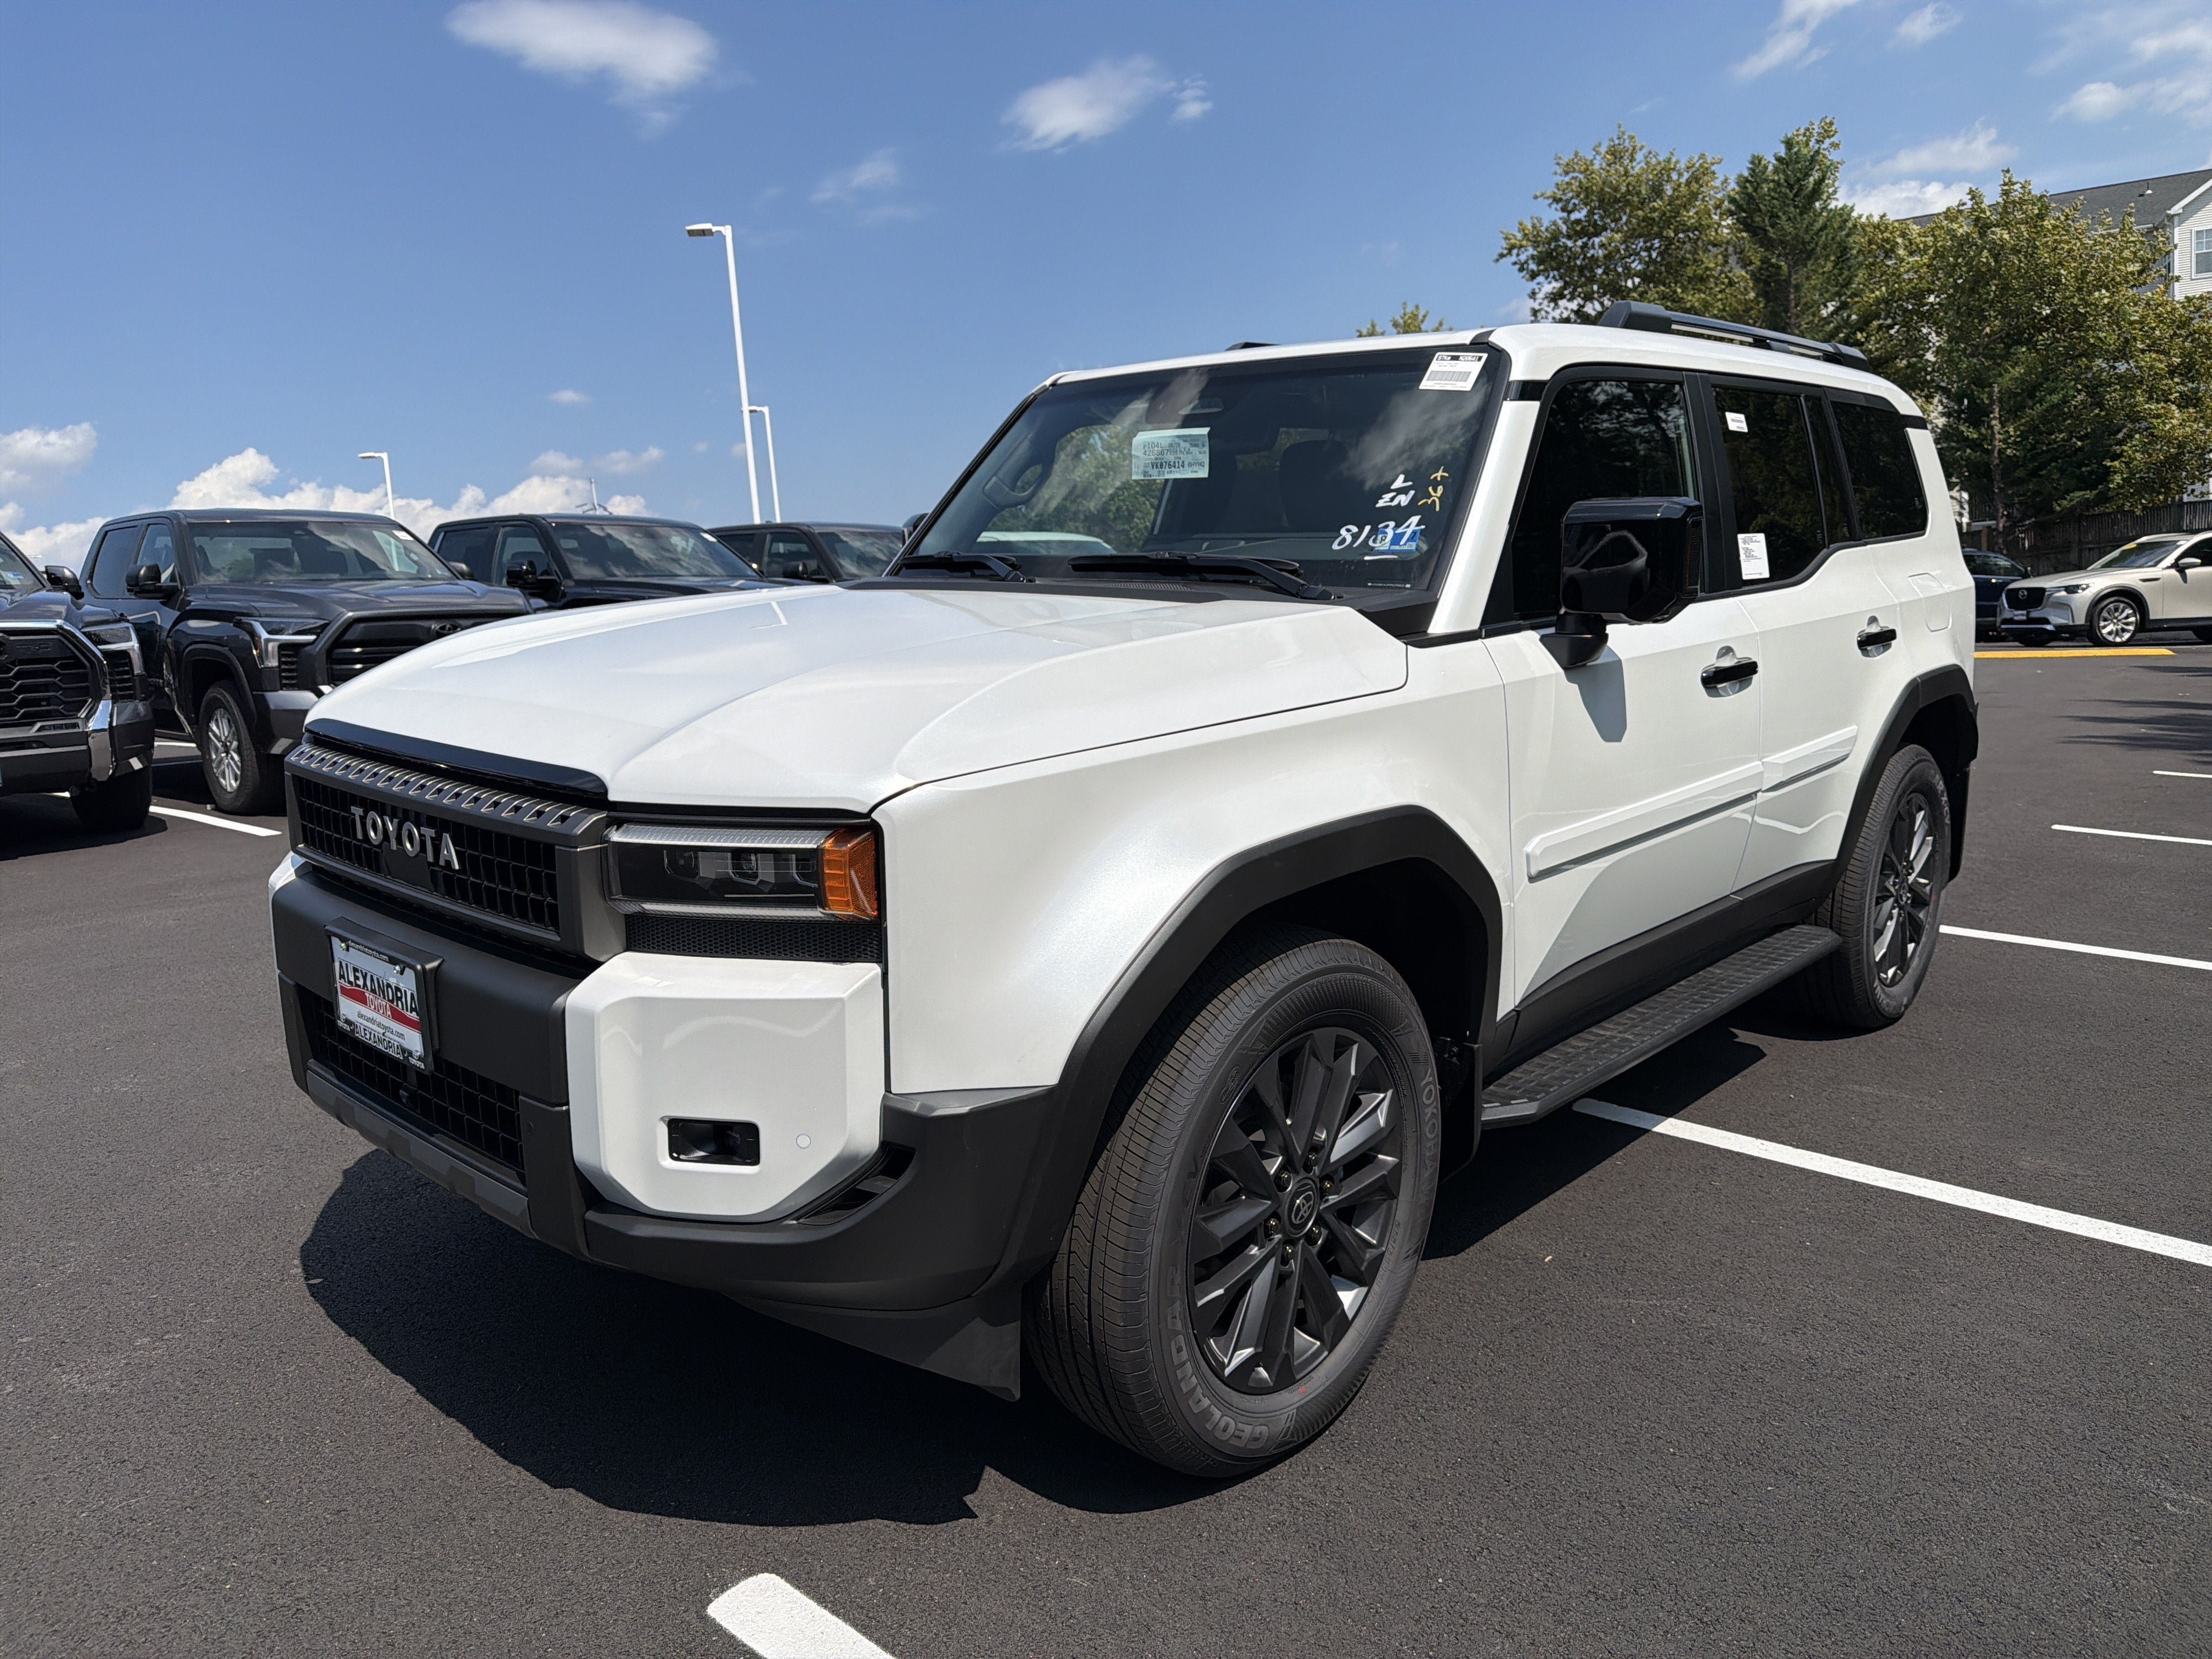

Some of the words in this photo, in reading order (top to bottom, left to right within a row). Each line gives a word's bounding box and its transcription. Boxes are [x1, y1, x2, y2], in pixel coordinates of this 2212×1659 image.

[1150, 460, 1185, 470] VK076414
[1331, 515, 1426, 550] 8134
[351, 805, 459, 870] TOYOTA
[338, 960, 419, 1017] ALEXANDRIA
[365, 992, 392, 1019] TOYOTA
[355, 1022, 404, 1060] ALEXANDRIA
[357, 1010, 405, 1041] alexandriatoyota.com
[408, 1056, 425, 1070] TOYOTA
